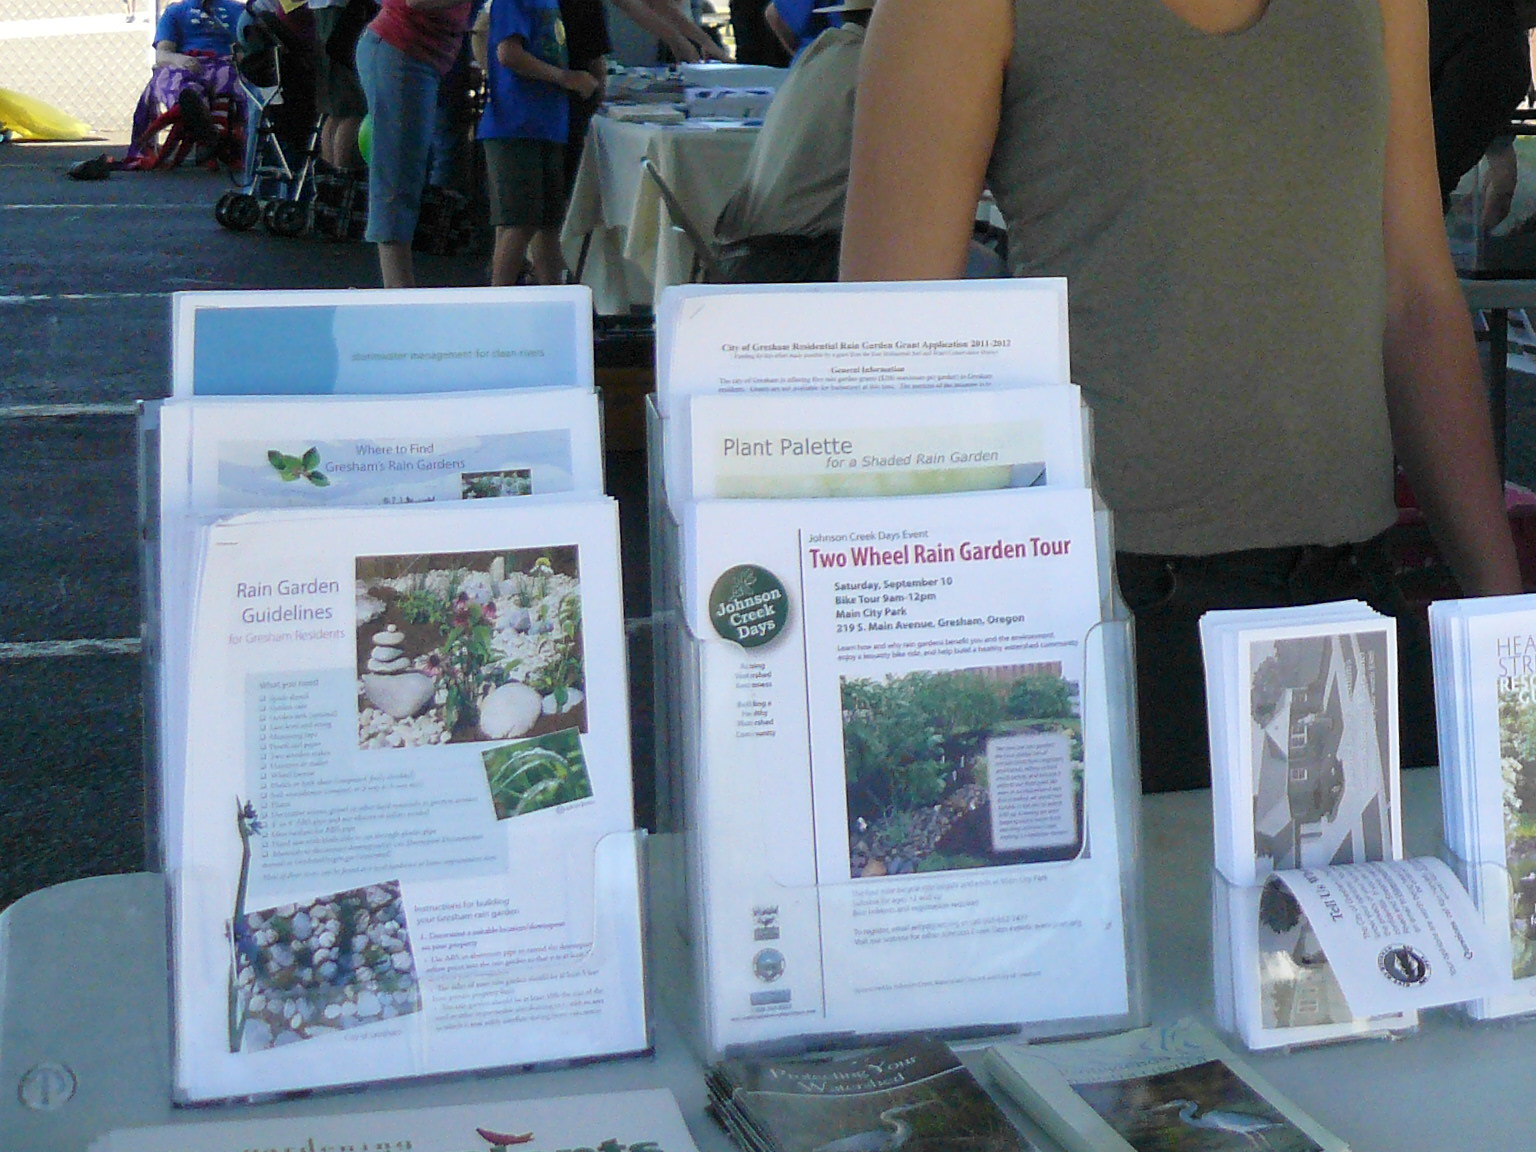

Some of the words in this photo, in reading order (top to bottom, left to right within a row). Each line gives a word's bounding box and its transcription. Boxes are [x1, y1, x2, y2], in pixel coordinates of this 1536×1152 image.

[793, 341, 838, 351] Residential
[895, 340, 920, 349] Grant
[923, 339, 968, 350] Application
[356, 444, 394, 456] Where
[396, 444, 408, 455] to
[410, 443, 435, 455] Find
[723, 437, 773, 457] Plant
[780, 436, 853, 456] Palette
[325, 460, 386, 473] Gresham's
[388, 459, 413, 472] Rain
[416, 458, 466, 471] Gardens
[825, 455, 846, 469] for
[850, 459, 857, 468] a
[862, 454, 912, 468] Shaded
[916, 452, 946, 465] Rain
[950, 450, 1000, 464] Garden
[808, 532, 848, 544] Johnson
[849, 531, 877, 542] Creek
[878, 530, 901, 543] Days
[903, 529, 929, 540] Event
[809, 548, 847, 569] Two
[849, 544, 910, 567] Wheel
[914, 542, 955, 564] Rain
[959, 539, 1027, 562] Garden
[1030, 536, 1072, 557] Tour
[237, 581, 273, 598] Rain
[277, 578, 340, 596] Garden
[834, 581, 882, 593] Saturday,
[883, 577, 939, 591] September
[941, 576, 953, 586] 10
[716, 588, 782, 617] Johnson
[858, 594, 881, 604] Tour
[242, 604, 334, 624] Guidelines
[729, 604, 776, 627] Creek
[836, 608, 862, 619] Main
[863, 608, 883, 620] City
[884, 607, 908, 617] Park
[737, 619, 776, 640] Days
[836, 623, 855, 633] 219
[857, 622, 867, 632] S.
[868, 621, 894, 632] Main
[895, 619, 936, 630] Avenue,
[938, 617, 986, 629] Gresham,
[987, 614, 1025, 627] Oregon
[228, 633, 242, 646] for
[294, 629, 346, 641] Residents
